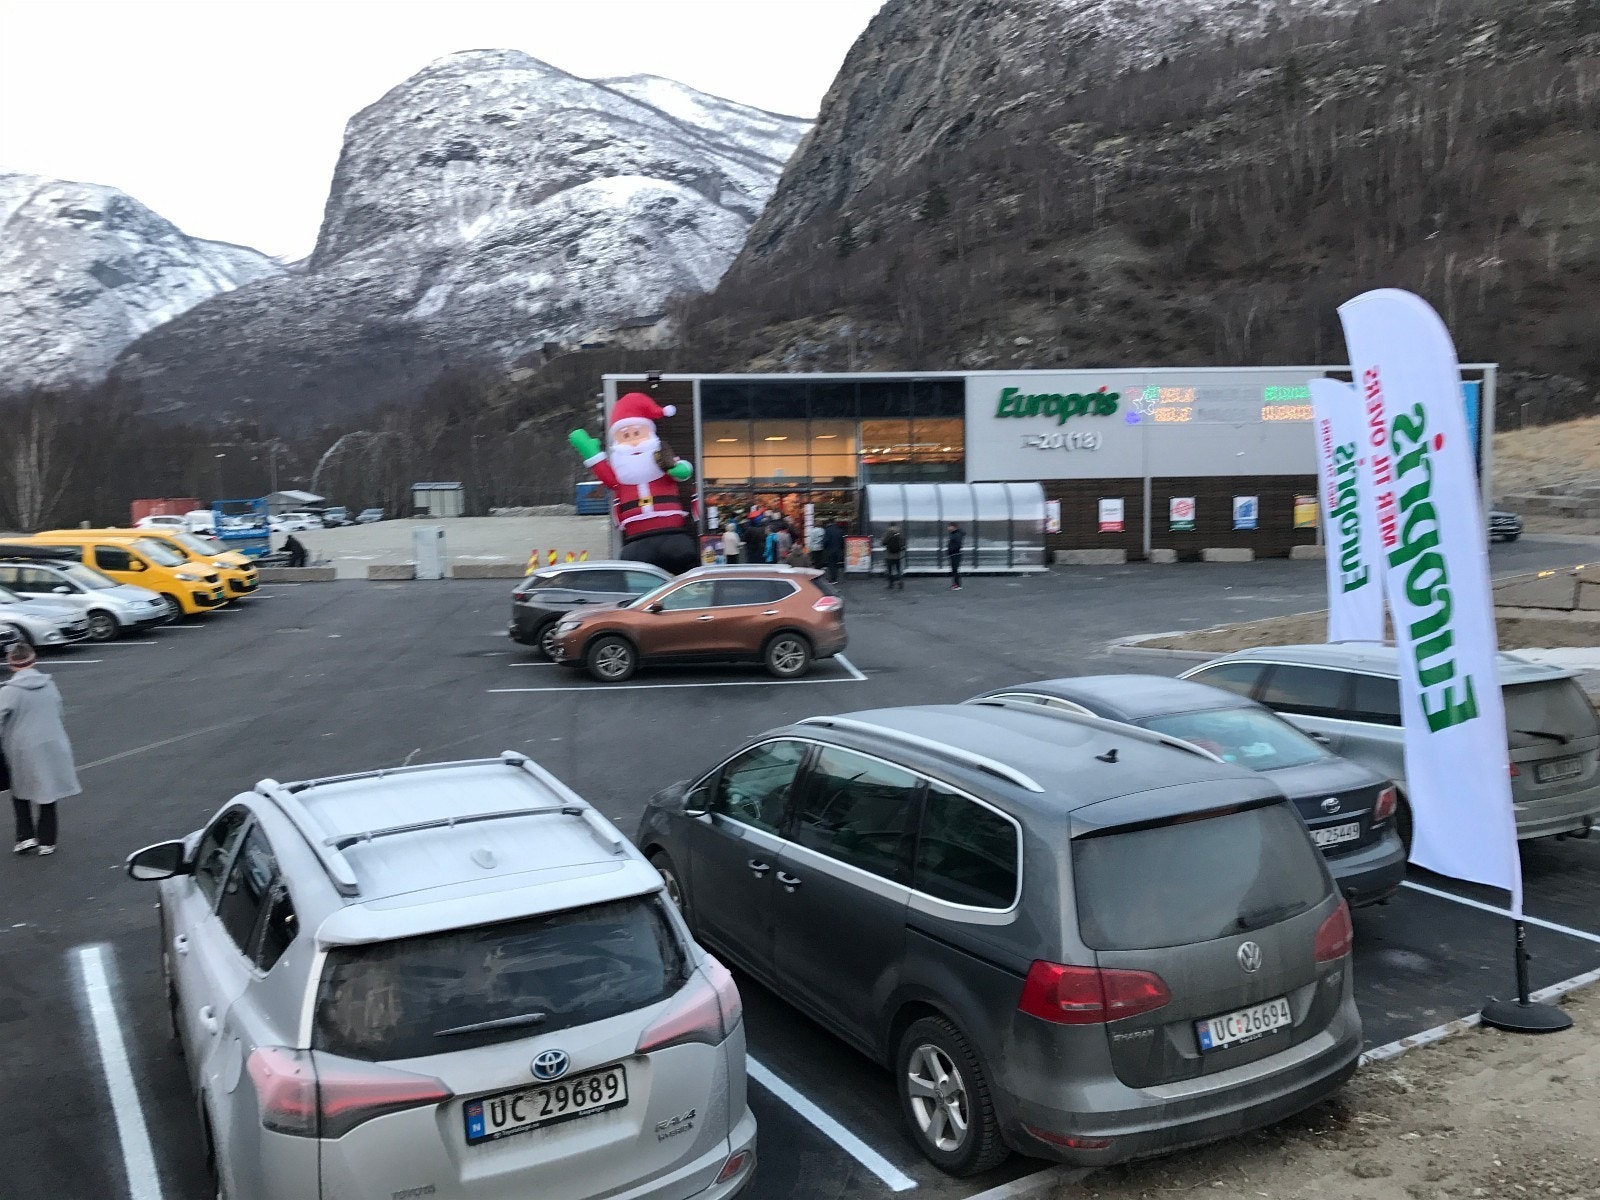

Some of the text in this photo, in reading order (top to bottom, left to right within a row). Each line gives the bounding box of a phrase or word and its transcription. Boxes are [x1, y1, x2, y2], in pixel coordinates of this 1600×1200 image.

[995, 385, 1120, 426] Europris
[1325, 824, 1359, 843] 25449
[1214, 1018, 1237, 1041] UC
[1243, 1001, 1290, 1034] 26694
[490, 1073, 619, 1127] UC 29689
